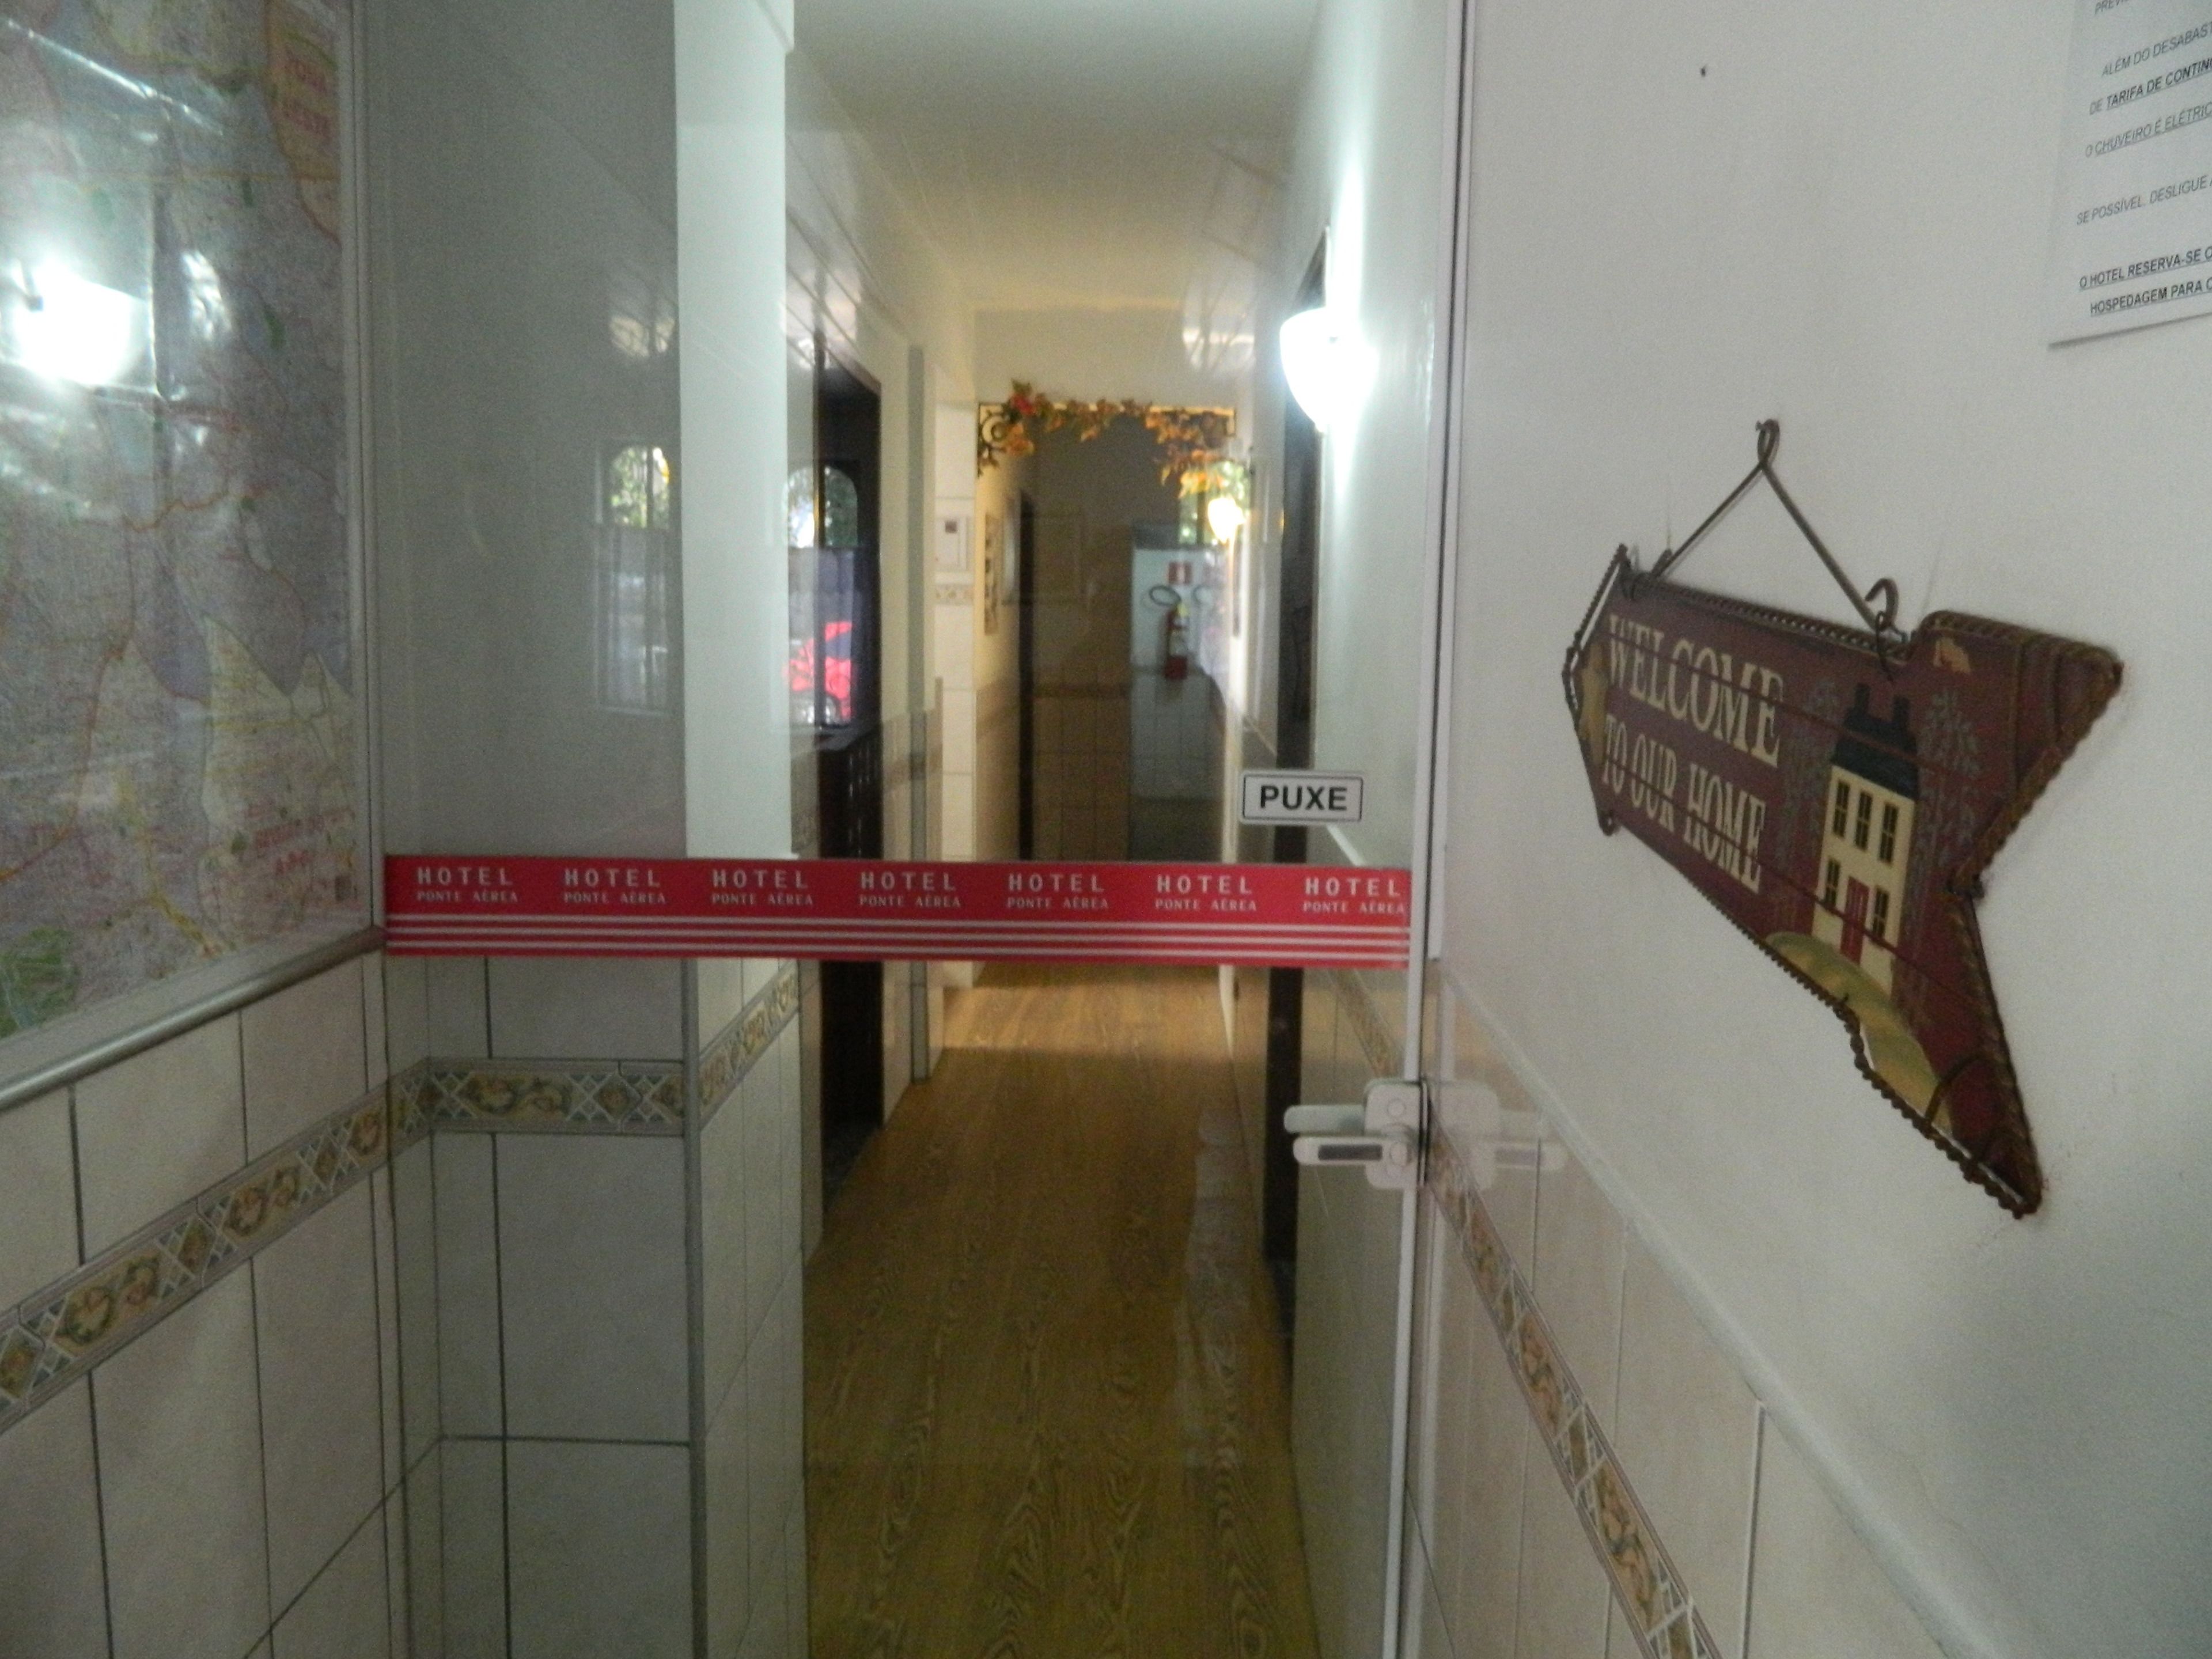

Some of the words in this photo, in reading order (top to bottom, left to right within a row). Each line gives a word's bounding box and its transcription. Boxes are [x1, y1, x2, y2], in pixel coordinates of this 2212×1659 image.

[2134, 48, 2150, 65] DO
[2089, 99, 2103, 115] DE
[2107, 85, 2143, 108] TARIFA
[2147, 76, 2162, 93] DE
[2165, 58, 2212, 86] CONTIN
[2085, 145, 2093, 158] O
[2095, 124, 2152, 155] CHUVEIRO
[2077, 210, 2089, 225] SE
[2150, 175, 2207, 204] DESLIGUE
[2080, 276, 2087, 288] O
[2090, 268, 2124, 286] HOTEL
[2127, 249, 2201, 276] RESERVA-SE
[2090, 287, 2167, 314] HOSPEDAGEM
[2171, 281, 2202, 298] PARA
[1610, 615, 1783, 768] WELCOME
[1260, 785, 1347, 810] PUXE
[1603, 715, 1627, 794] TO
[1630, 734, 1677, 832] OUR
[1683, 764, 1765, 894] HOME
[416, 866, 512, 886] HOTEL
[564, 868, 660, 888] HOTEL
[712, 869, 807, 889] HOTEL
[861, 872, 955, 891] HOTEL
[1009, 873, 1104, 893] HOTEL
[1157, 875, 1252, 895] HOTEL
[417, 891, 459, 902] PONTE
[1305, 877, 1400, 897] HOTEL
[564, 892, 608, 904] PONTE
[711, 893, 756, 906] PONTE
[860, 895, 904, 907] PONTE
[1007, 897, 1051, 909] PONTE
[1156, 900, 1200, 911] PONTE
[1303, 901, 1347, 912] PONTE
